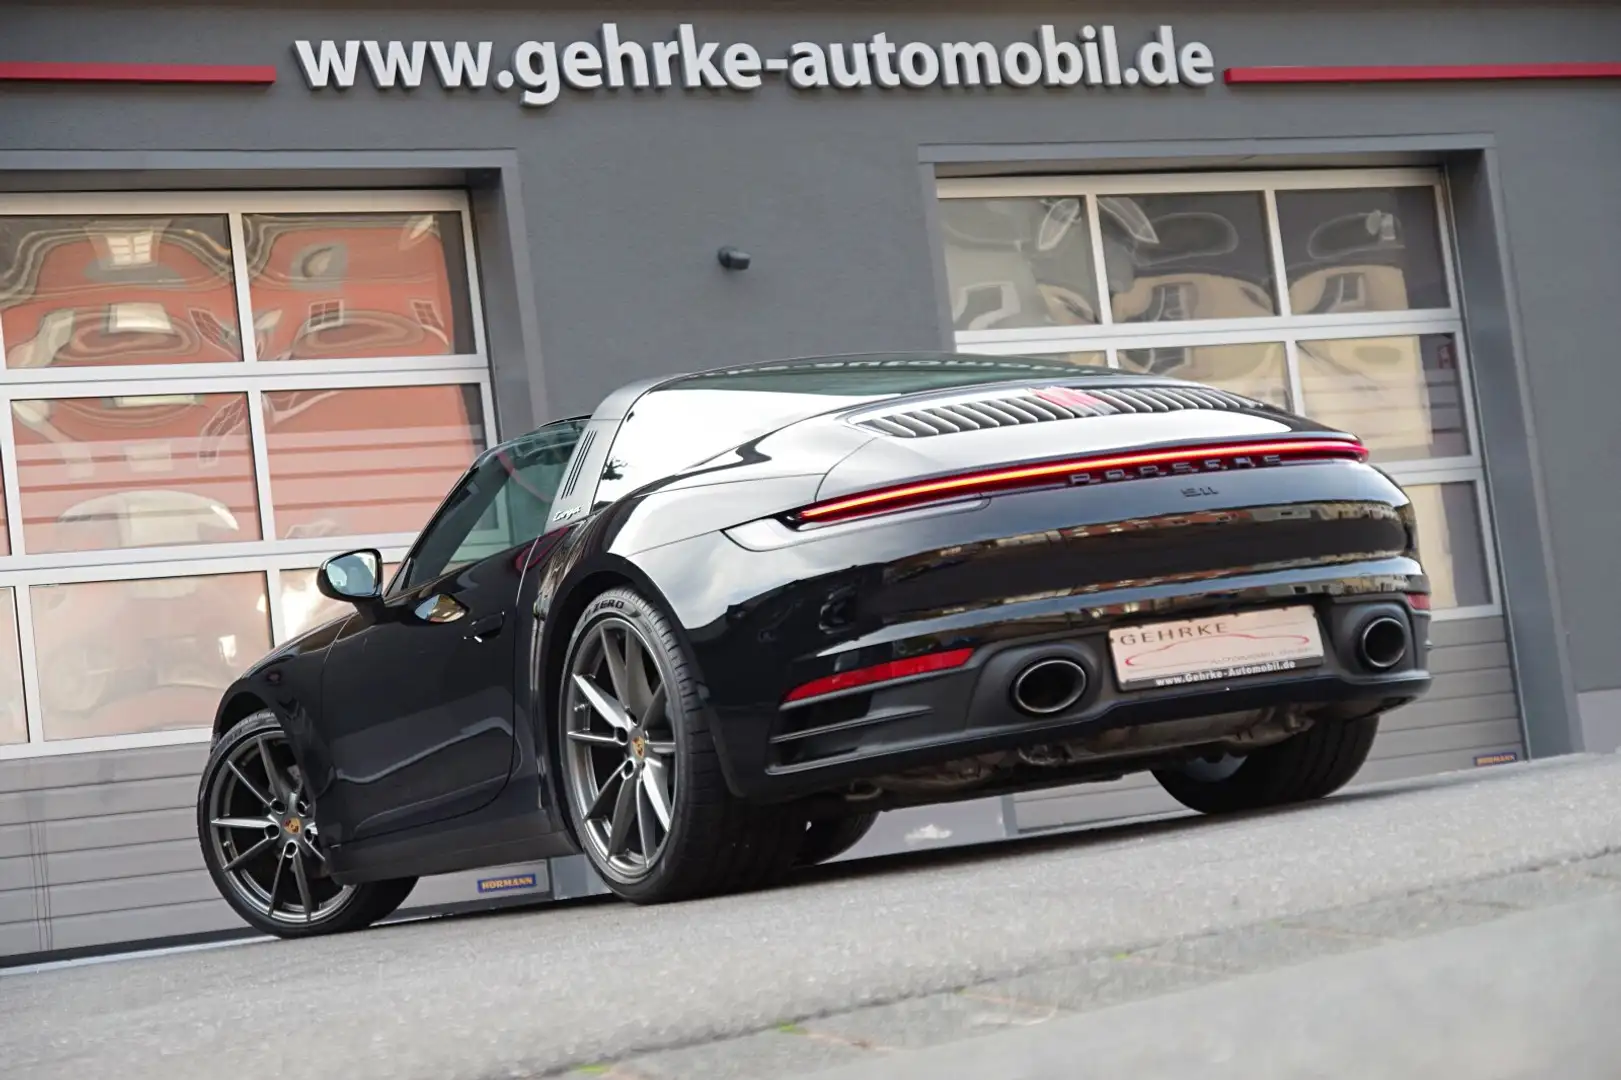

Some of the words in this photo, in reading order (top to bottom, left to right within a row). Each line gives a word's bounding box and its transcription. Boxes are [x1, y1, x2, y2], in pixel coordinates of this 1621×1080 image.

[294, 23, 1215, 105] www.gehrke-automobil.de
[1120, 622, 1228, 645] GEHRKE
[1155, 660, 1296, 686] www.Gehrke-Automobil.de
